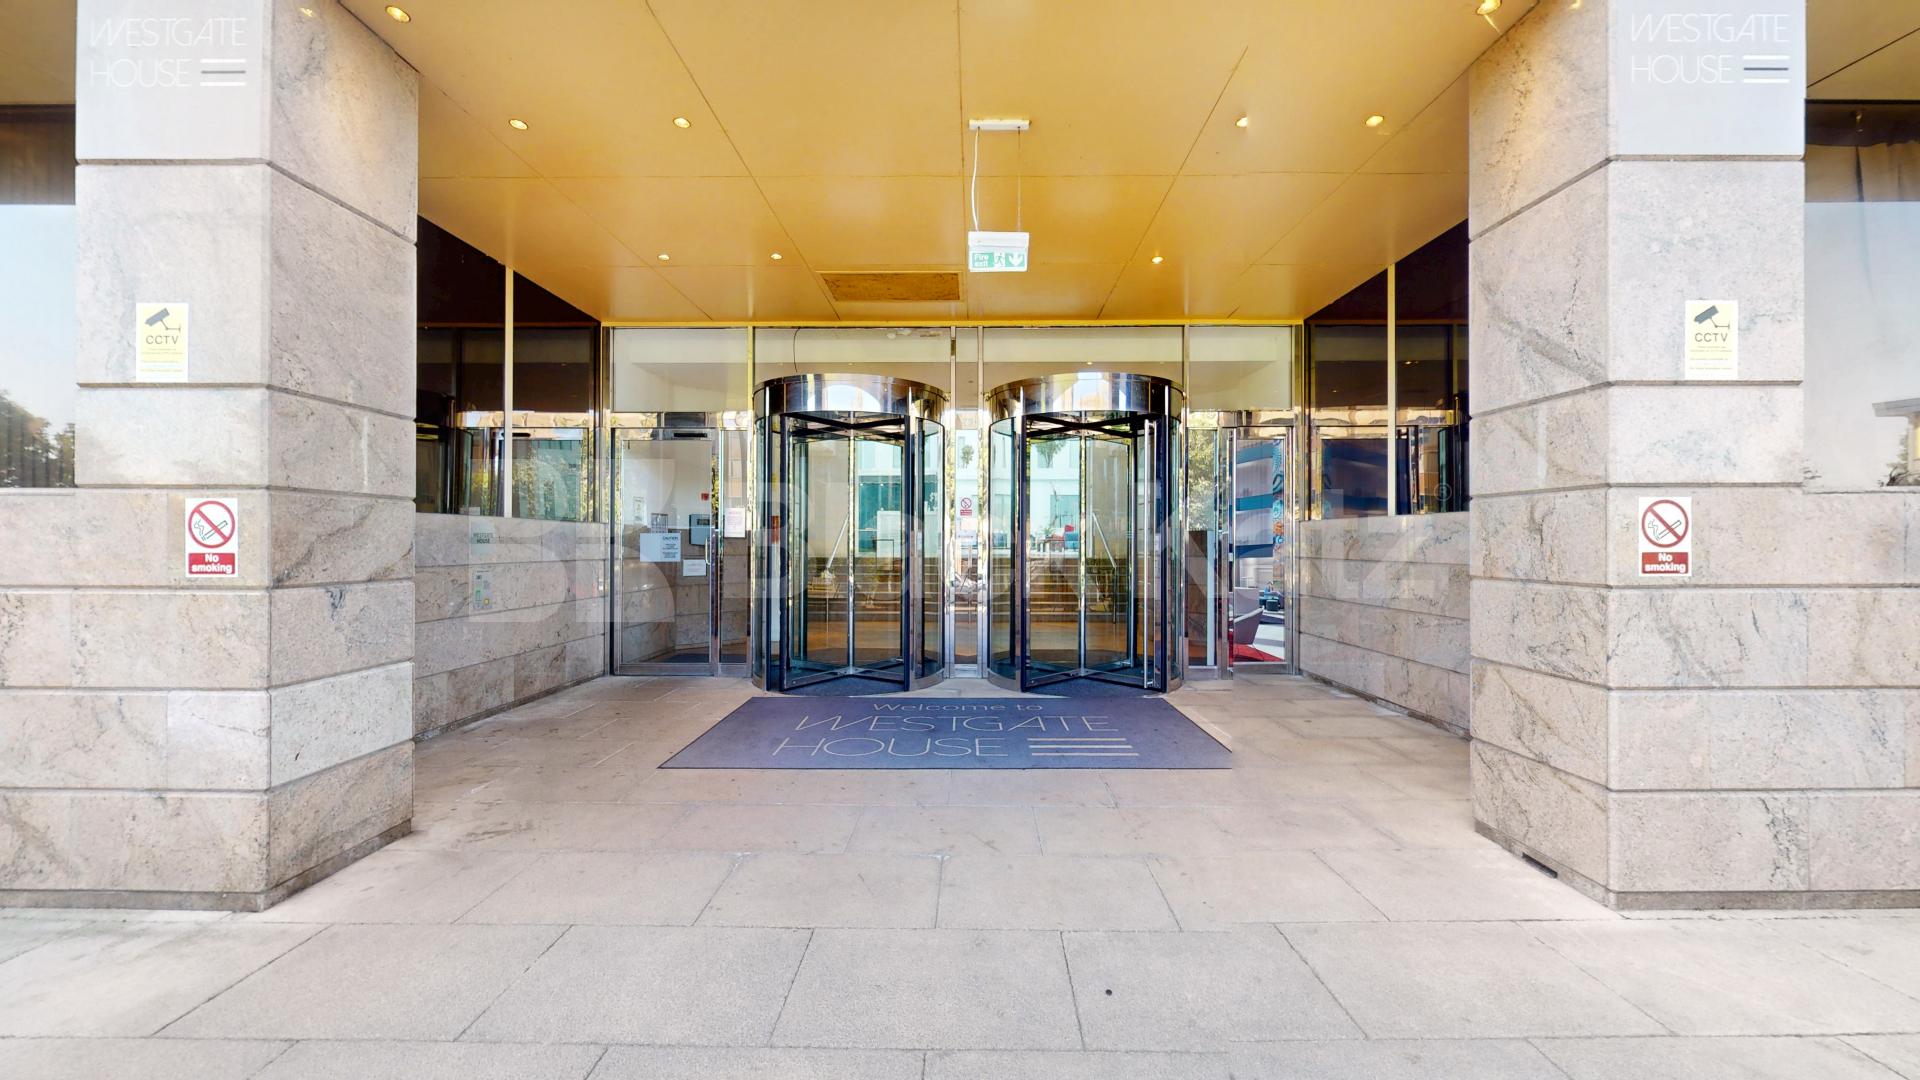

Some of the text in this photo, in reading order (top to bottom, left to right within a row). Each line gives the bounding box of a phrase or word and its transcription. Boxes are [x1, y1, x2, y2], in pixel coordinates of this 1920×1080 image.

[90, 17, 248, 47] WESTGATE
[1631, 13, 1791, 42] WESTGATE
[90, 58, 193, 88] HOUSE
[1631, 54, 1734, 84] HOUSE
[145, 335, 180, 345] CCTV
[1694, 332, 1729, 343] CCTV
[204, 553, 220, 563] No
[1658, 553, 1673, 562] No
[191, 563, 233, 575] smoking
[1645, 562, 1687, 573] smoking
[873, 703, 1043, 711] Welcome to
[795, 716, 1119, 731] WESTGATE
[772, 738, 1009, 756] HOUSE
